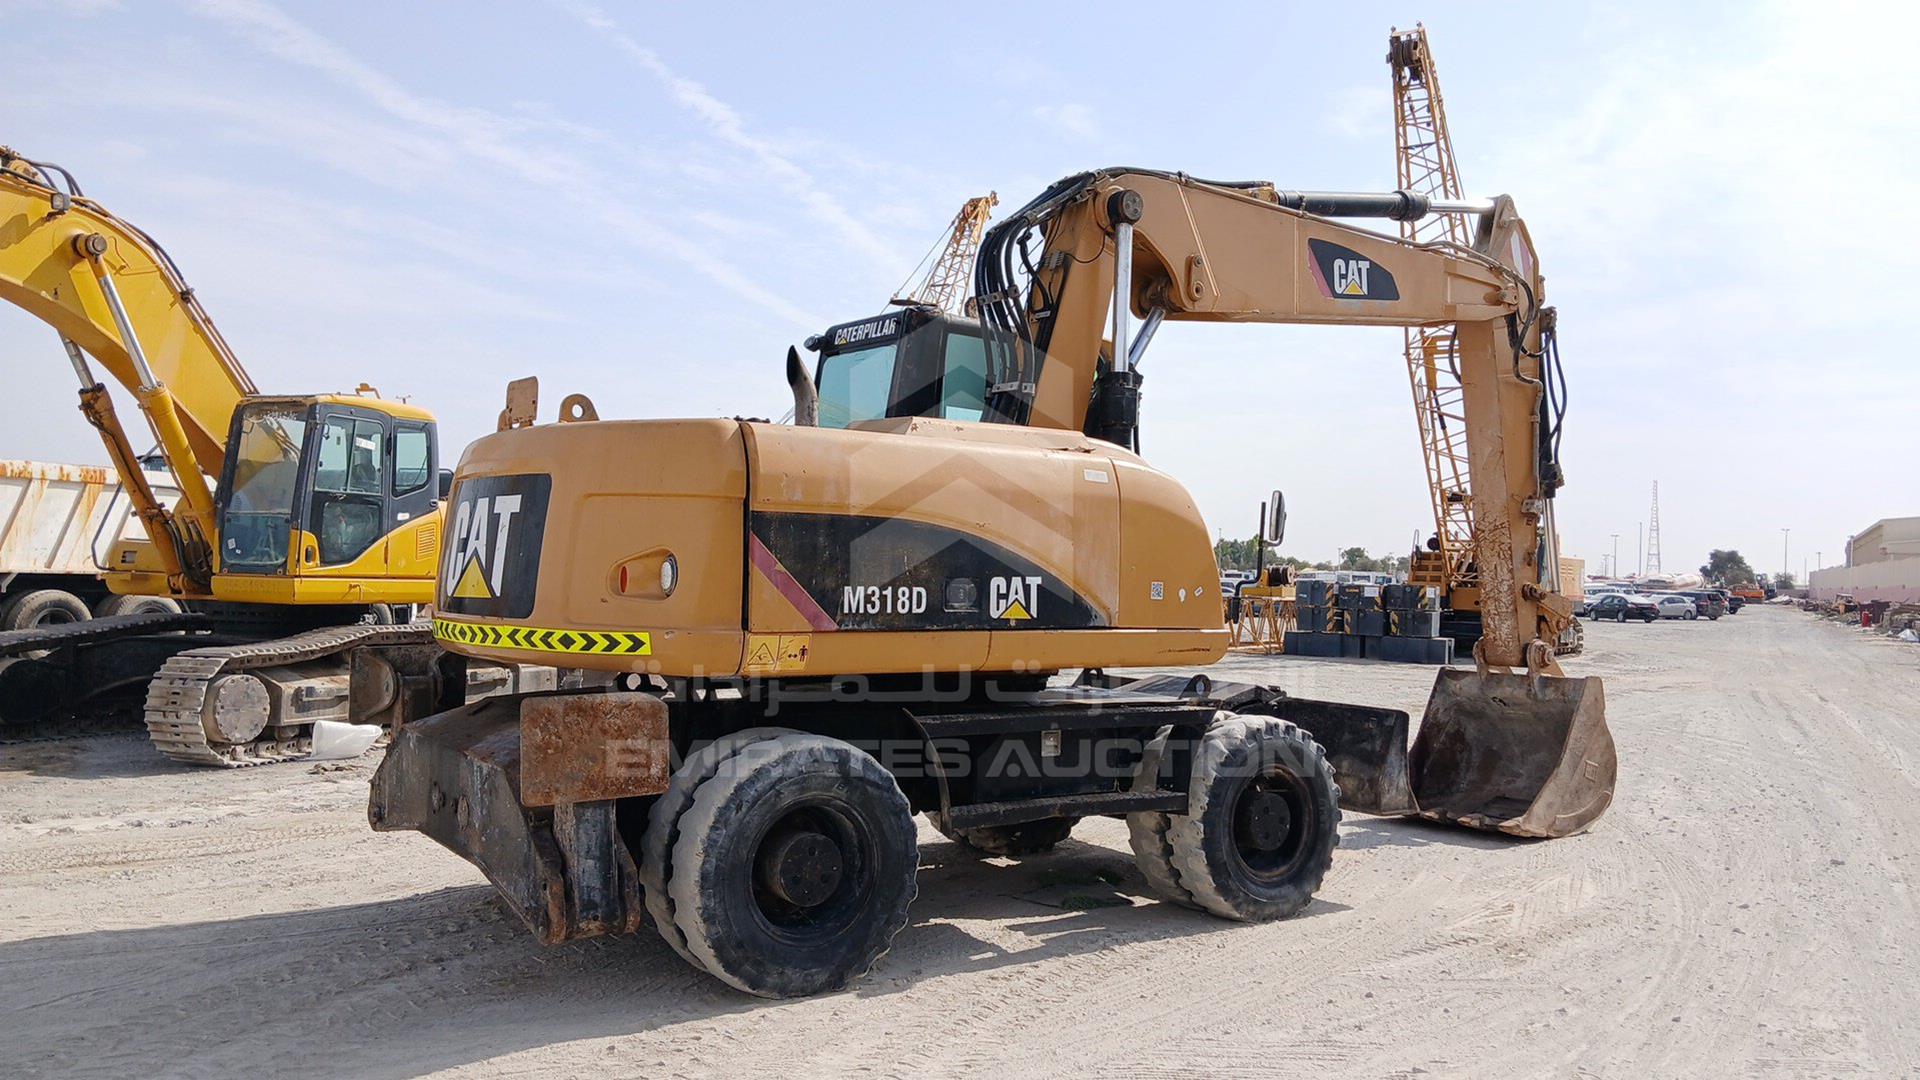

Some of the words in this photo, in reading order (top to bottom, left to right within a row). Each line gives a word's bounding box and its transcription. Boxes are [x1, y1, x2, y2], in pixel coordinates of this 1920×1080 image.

[1333, 258, 1370, 295] CAT
[834, 317, 898, 345] CATERPILLAR
[447, 494, 522, 597] CAT
[843, 586, 927, 614] M318D
[989, 576, 1042, 619] CAT
